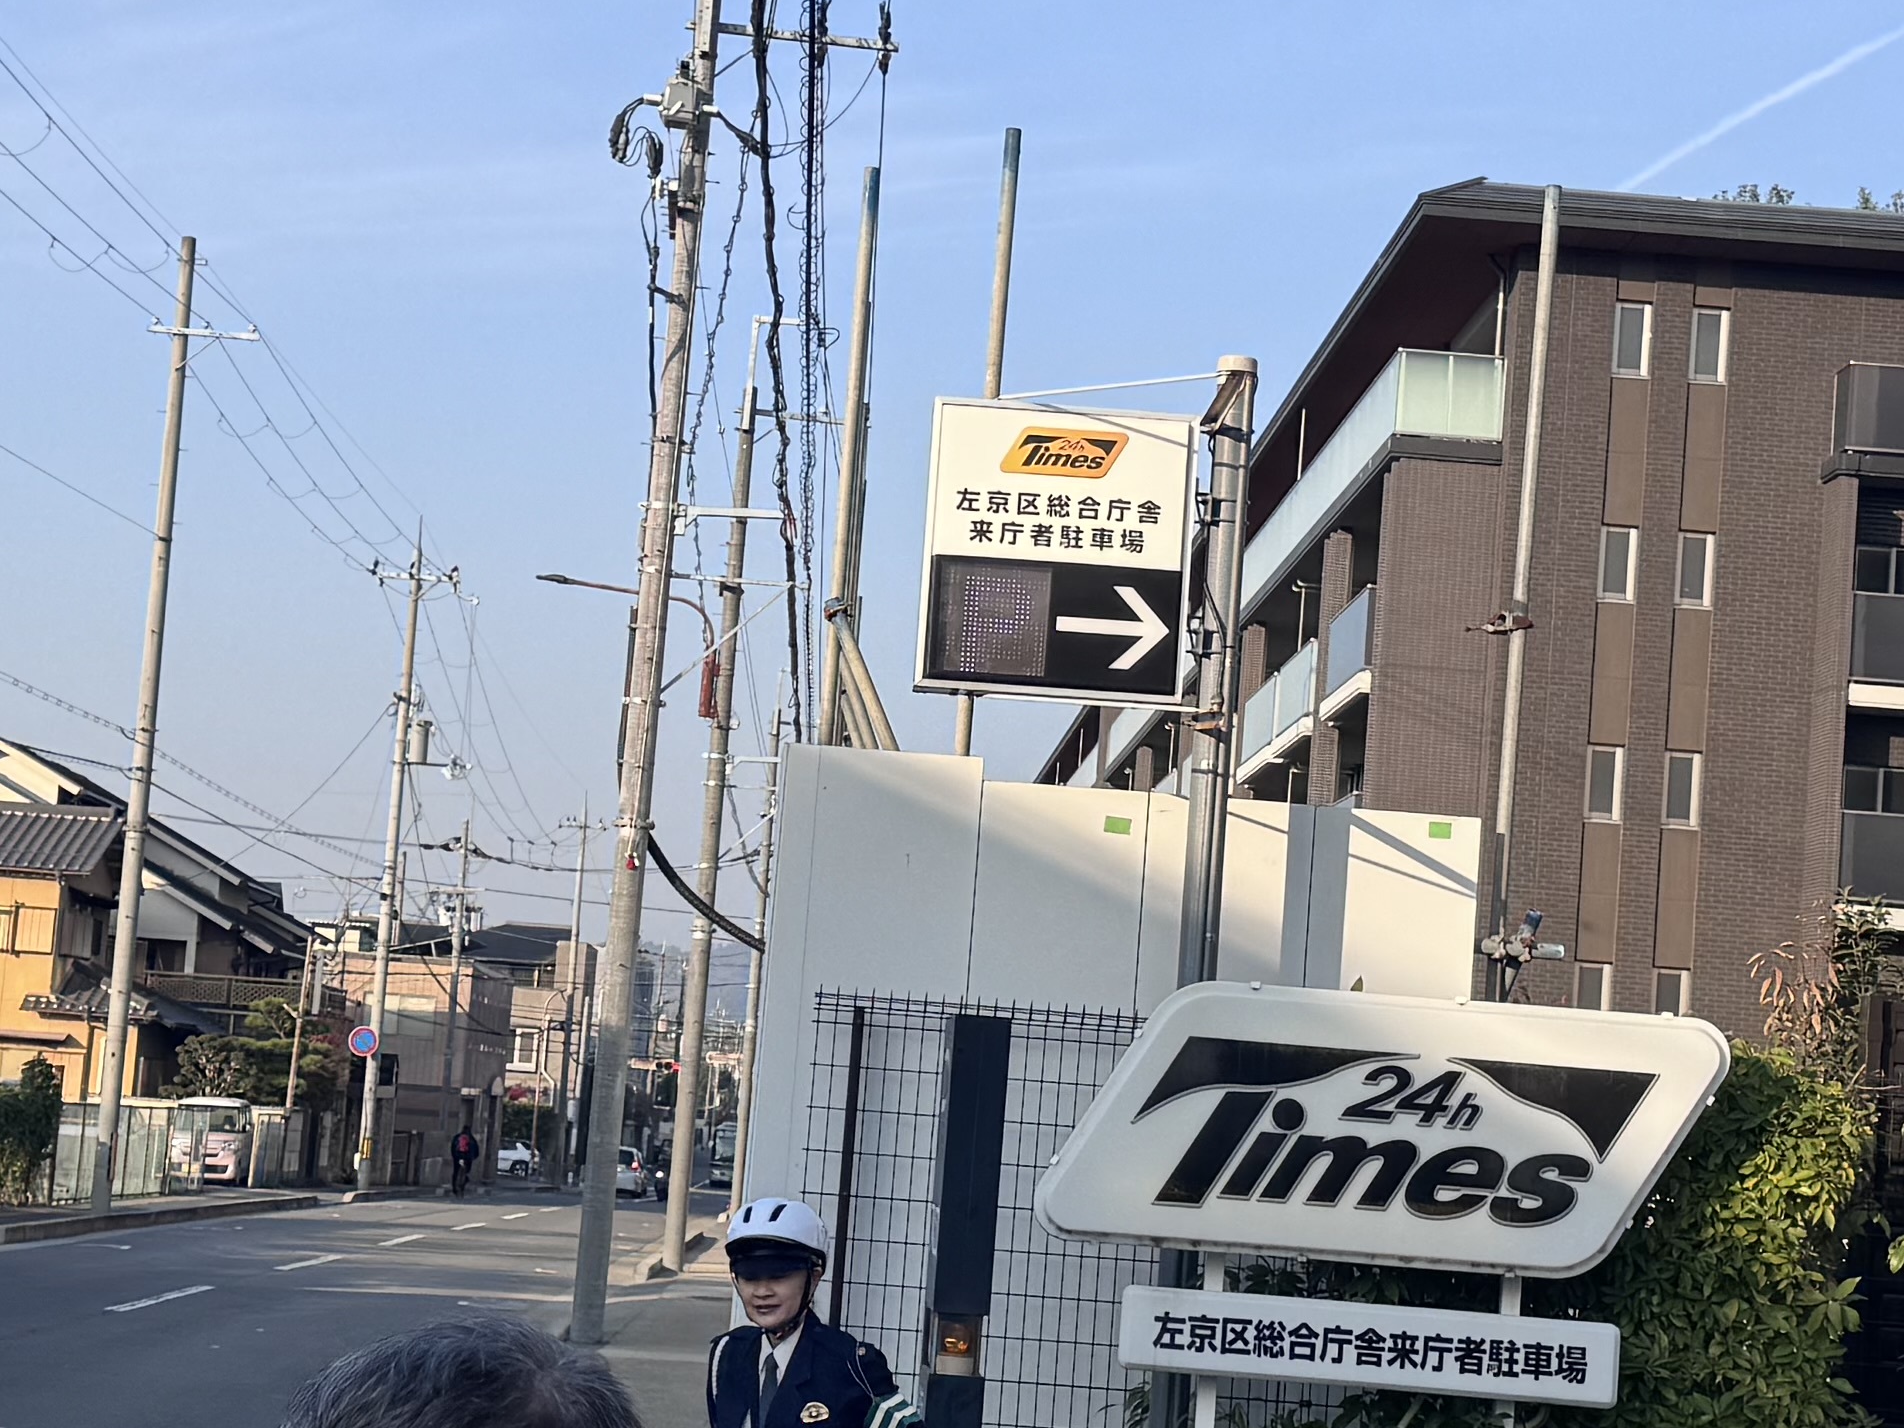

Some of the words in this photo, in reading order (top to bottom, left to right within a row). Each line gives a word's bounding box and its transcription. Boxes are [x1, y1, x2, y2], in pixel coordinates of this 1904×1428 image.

[1021, 443, 1106, 470] Times
[956, 487, 1162, 524] 左京区総合庁舎
[969, 519, 1145, 554] 来庁者駐車場
[1338, 1064, 1485, 1132] 24h
[1151, 1088, 1594, 1229] Times
[1152, 1310, 1589, 1384] 左京区総合庁舎来庁者駐車場
